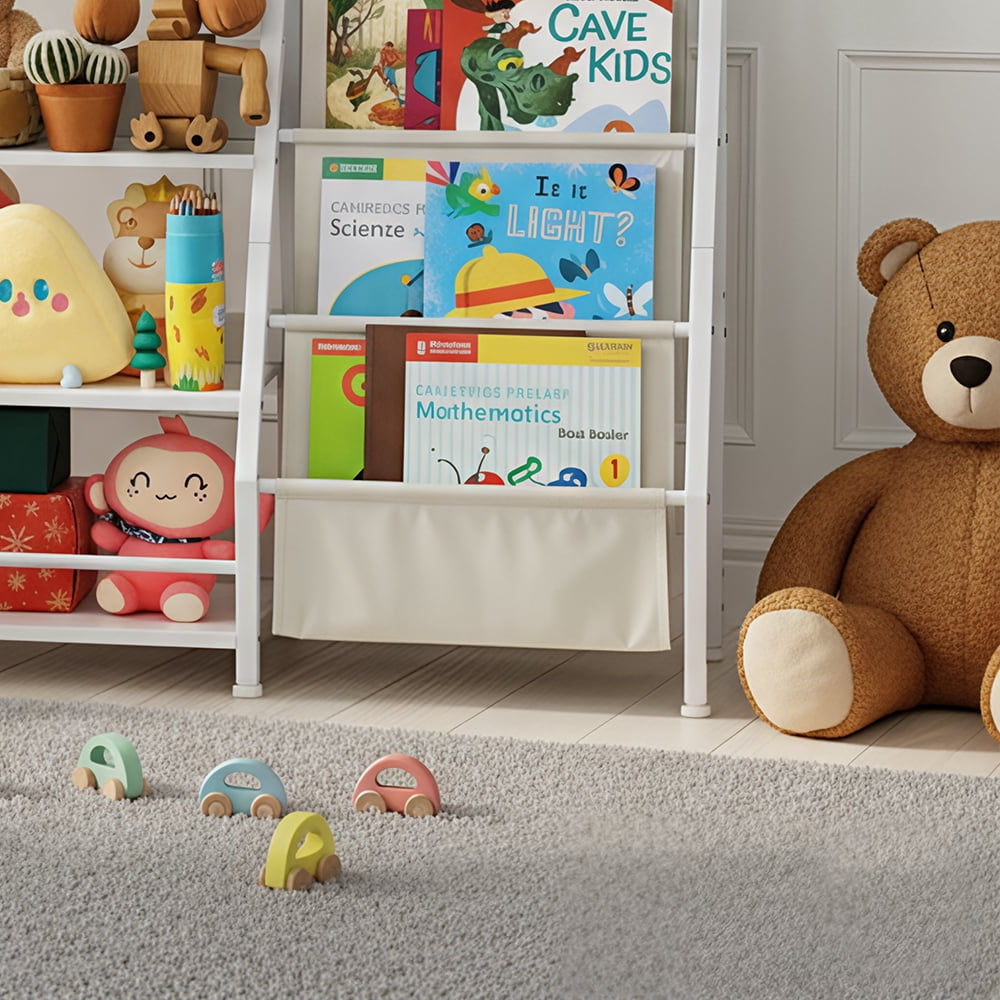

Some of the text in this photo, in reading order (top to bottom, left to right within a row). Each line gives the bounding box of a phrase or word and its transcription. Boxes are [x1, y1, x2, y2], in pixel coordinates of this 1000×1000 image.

[548, 2, 648, 43] CAVE
[589, 46, 672, 85] KIDS
[506, 203, 635, 248] LIGHT?
[610, 458, 618, 480] 1
